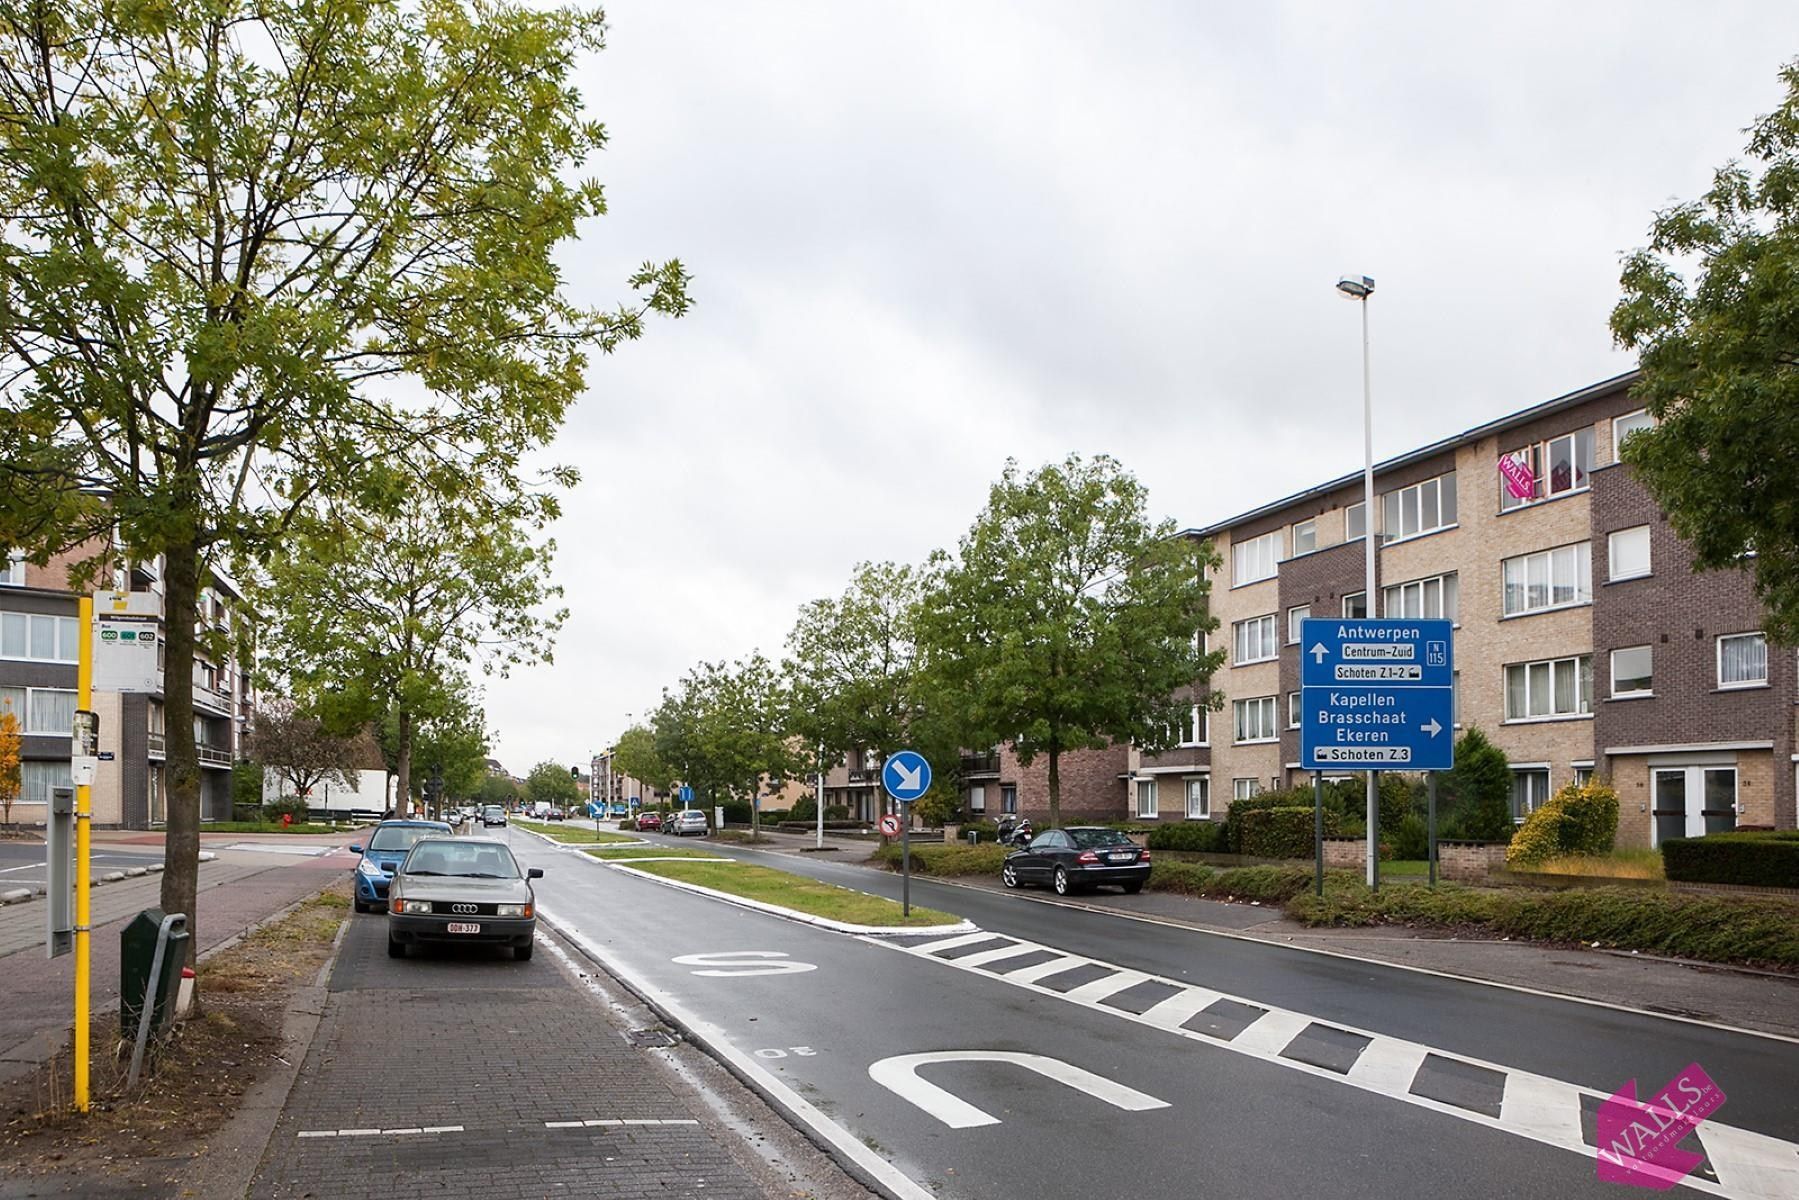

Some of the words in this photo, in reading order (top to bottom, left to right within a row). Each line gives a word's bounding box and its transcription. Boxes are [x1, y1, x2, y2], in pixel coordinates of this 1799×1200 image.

[1502, 455, 1531, 491] WALLS
[1337, 625, 1420, 642] Antwerpen
[1344, 646, 1413, 657] Centrum-Zuid
[1433, 644, 1439, 652] N
[1429, 653, 1444, 664] 115
[1337, 667, 1376, 678] Schoten
[1330, 693, 1395, 708] Kapellen
[1318, 711, 1406, 724] Brasschaat
[1336, 728, 1389, 742] Ekeren
[1331, 749, 1384, 760] Schoten
[1389, 749, 1409, 760] Z.3
